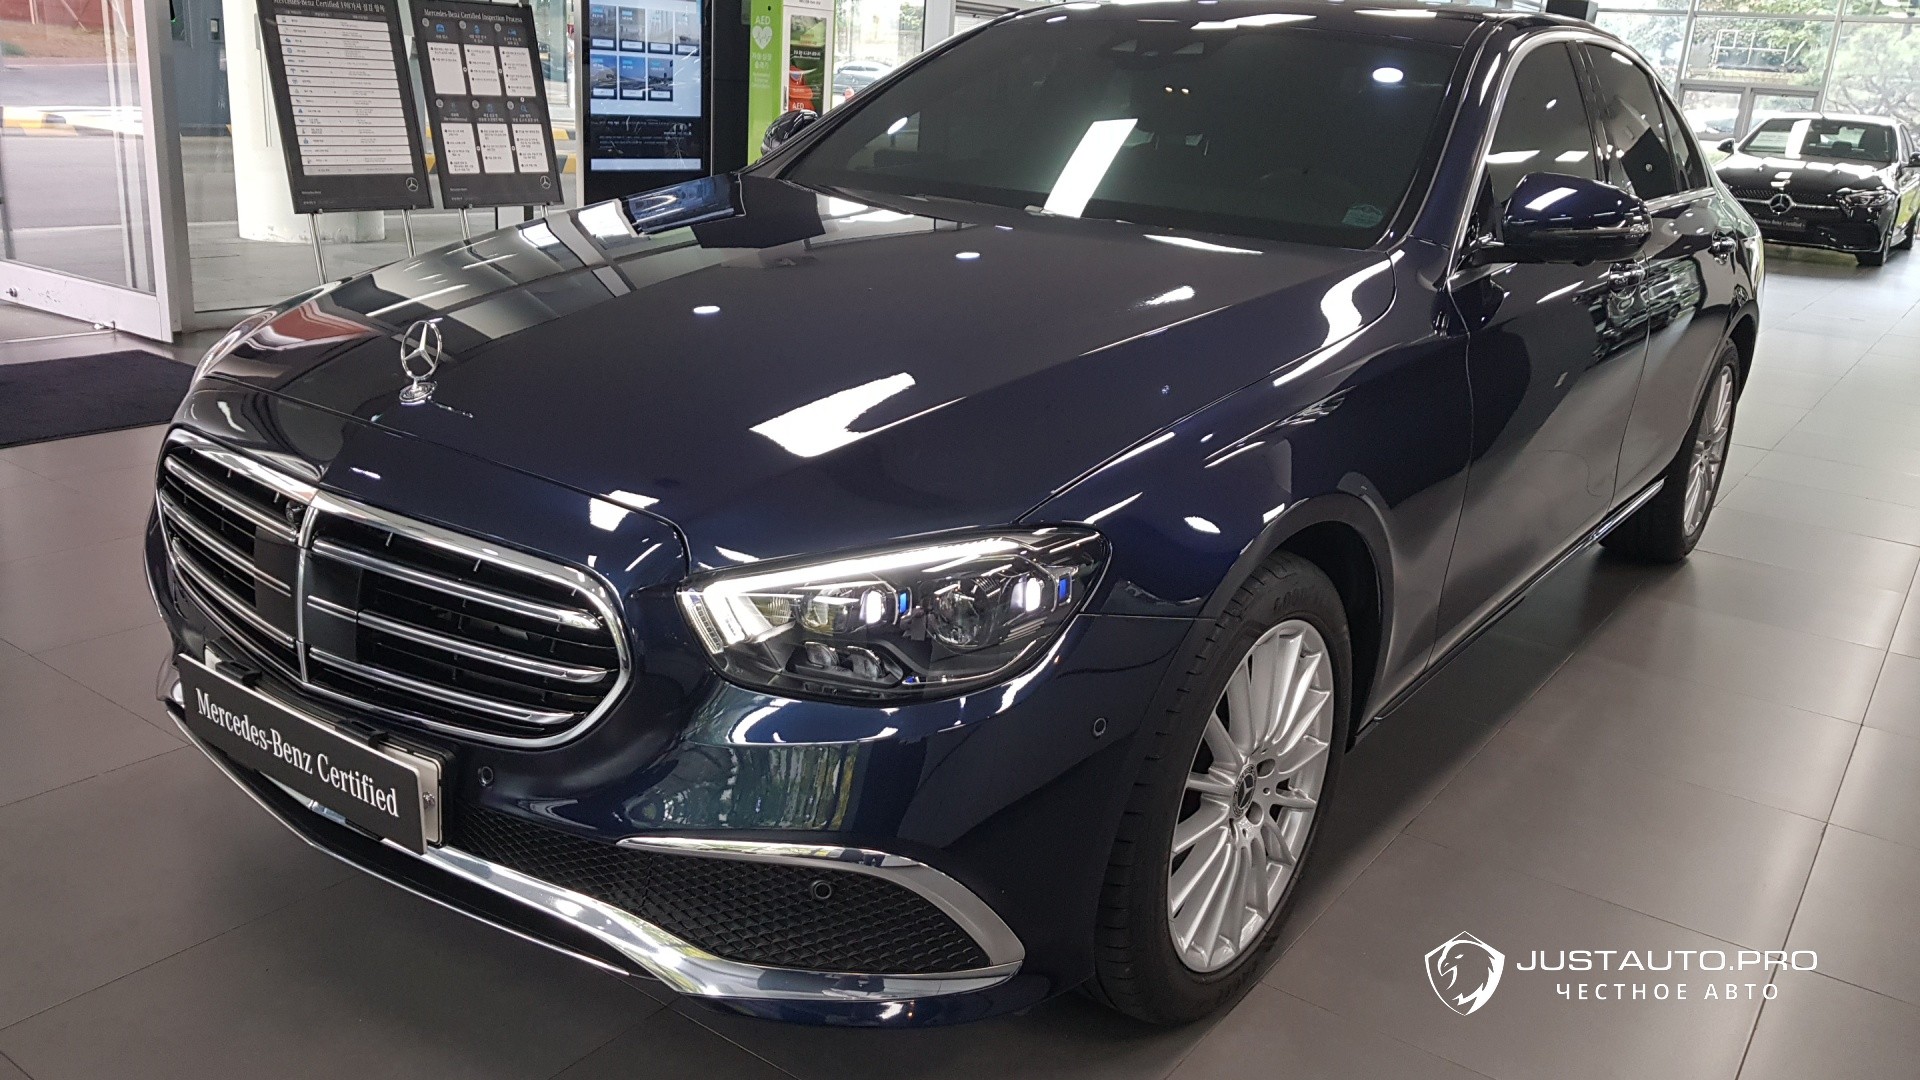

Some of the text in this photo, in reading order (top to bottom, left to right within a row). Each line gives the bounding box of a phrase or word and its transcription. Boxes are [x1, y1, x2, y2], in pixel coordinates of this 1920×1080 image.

[315, 0, 340, 9] Certified
[424, 8, 523, 23] Mercedes-Benz Certified Inspection Process
[755, 16, 771, 25] AED
[792, 102, 805, 110] AED
[195, 687, 400, 818] Mercedes-Benz Certified
